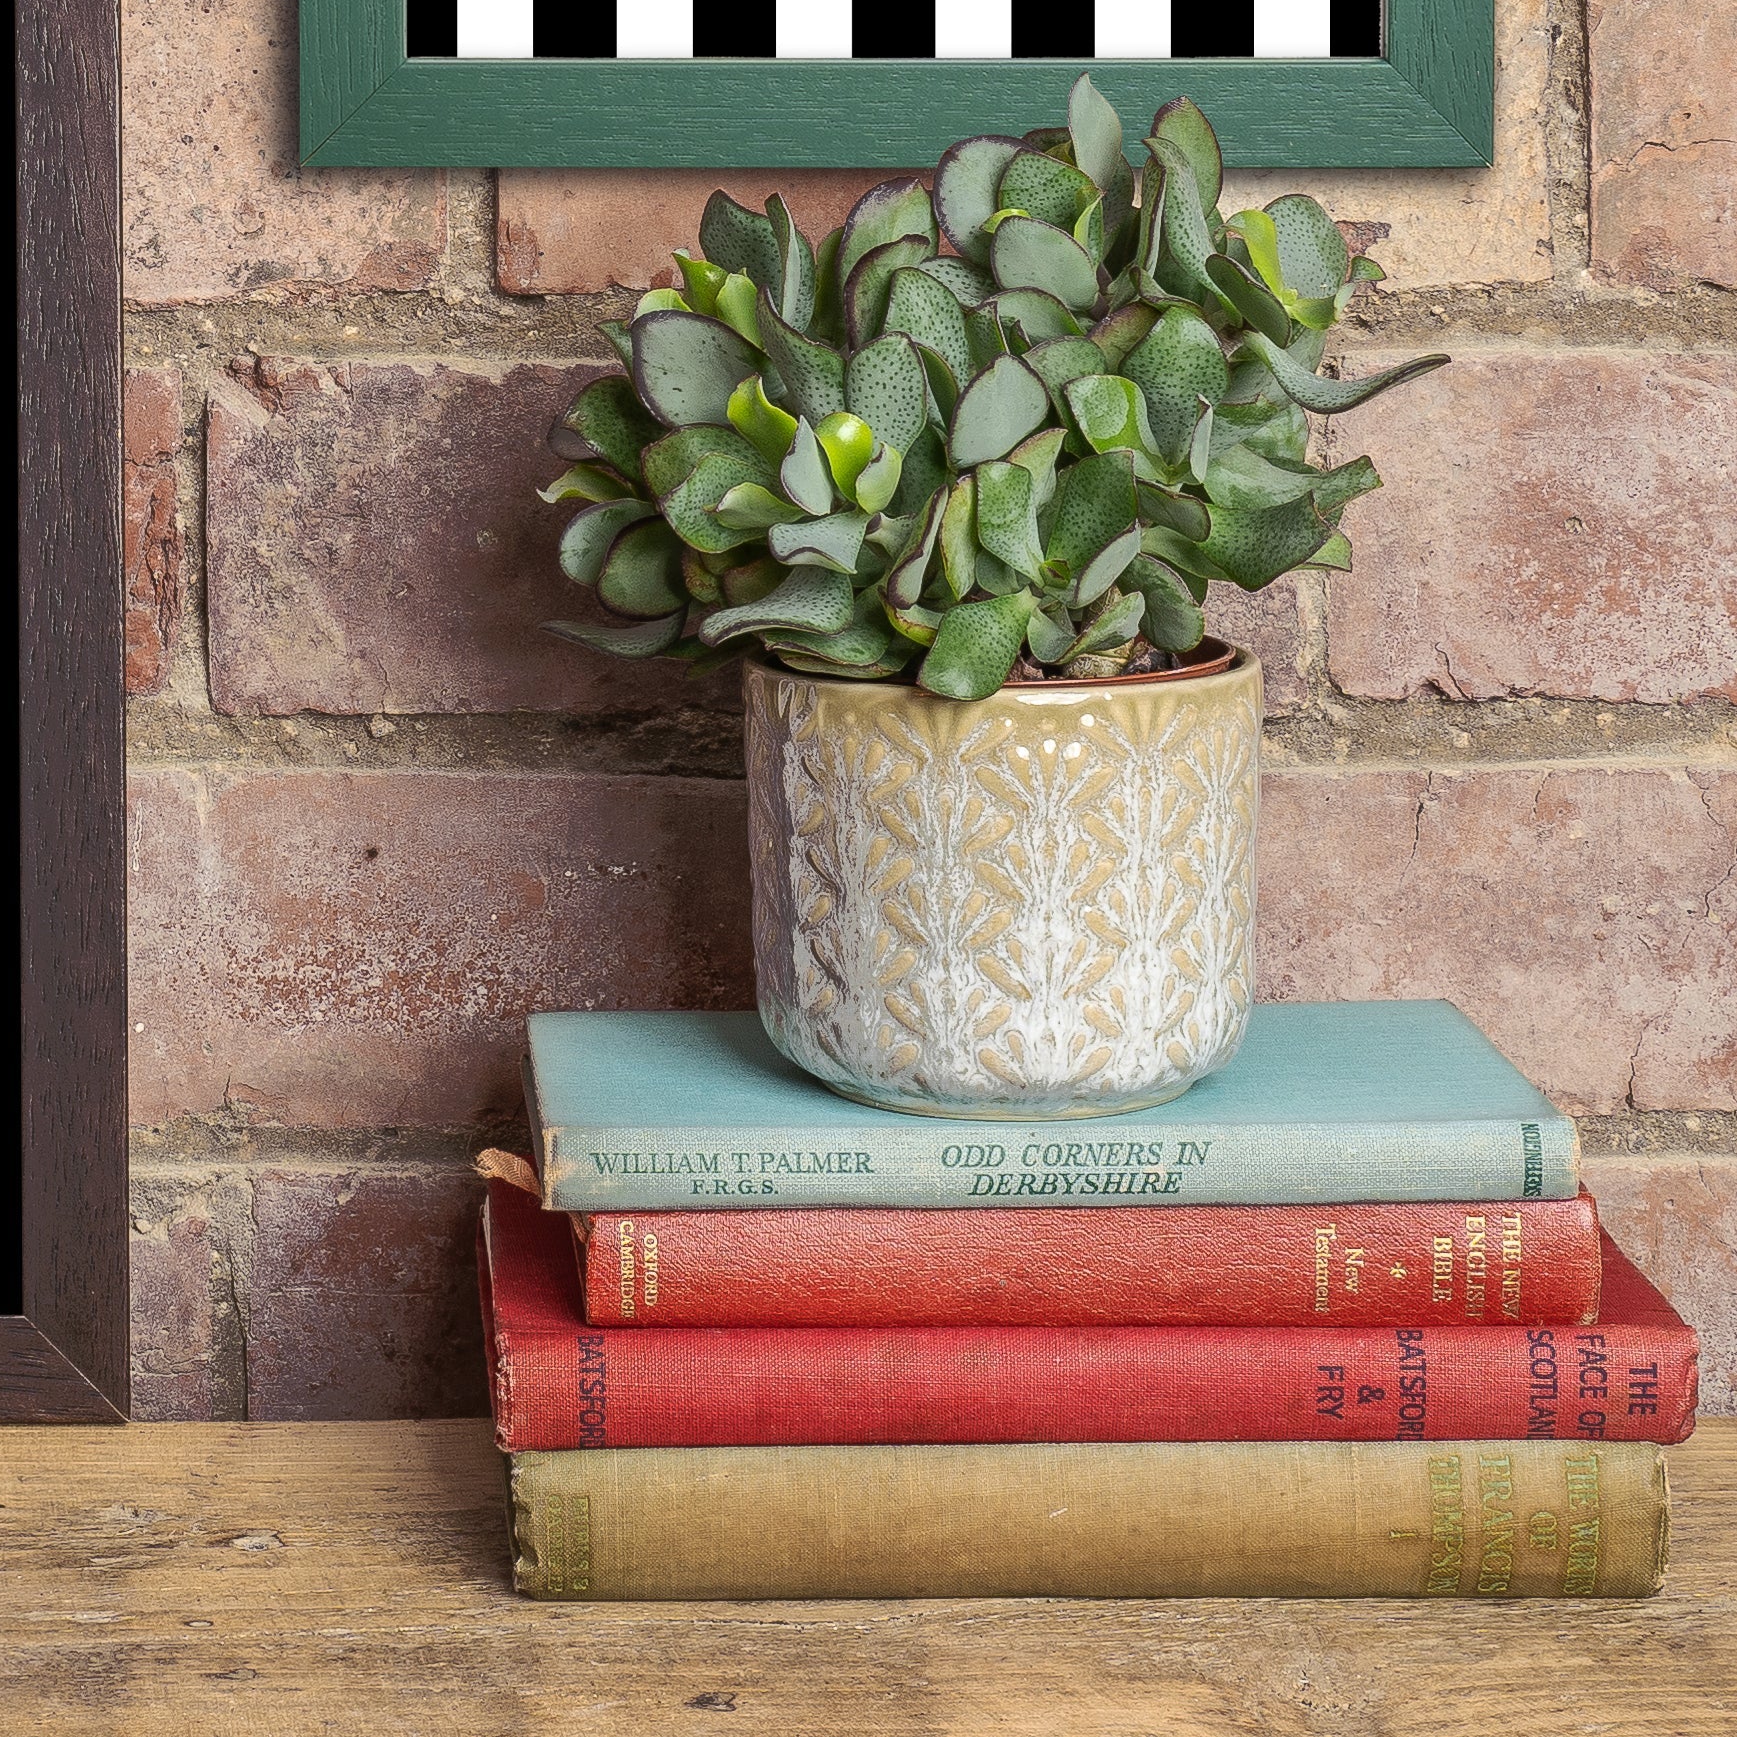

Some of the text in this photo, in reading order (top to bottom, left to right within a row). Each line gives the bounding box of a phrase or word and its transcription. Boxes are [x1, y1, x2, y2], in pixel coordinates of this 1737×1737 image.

[589, 1152, 720, 1174] WILLIAM
[941, 1141, 1213, 1167] ODD CORNERS IN
[967, 1171, 1184, 1195] DERBYSHIRE
[642, 1233, 660, 1307] OXFORD
[1344, 1248, 1365, 1294] New
[1432, 1235, 1454, 1303] BIBLE
[1465, 1214, 1487, 1318] ENGLISH
[1501, 1213, 1522, 1319] THE NEW
[1316, 1365, 1345, 1421] FRY
[1357, 1385, 1386, 1405] &
[1576, 1334, 1609, 1438] FACE OF
[1627, 1362, 1658, 1417] THE
[1565, 1454, 1599, 1510] THE
[1426, 1454, 1465, 1595] THOMPSON
[1477, 1454, 1514, 1594] FRANCIS
[1528, 1510, 1558, 1551] OF
